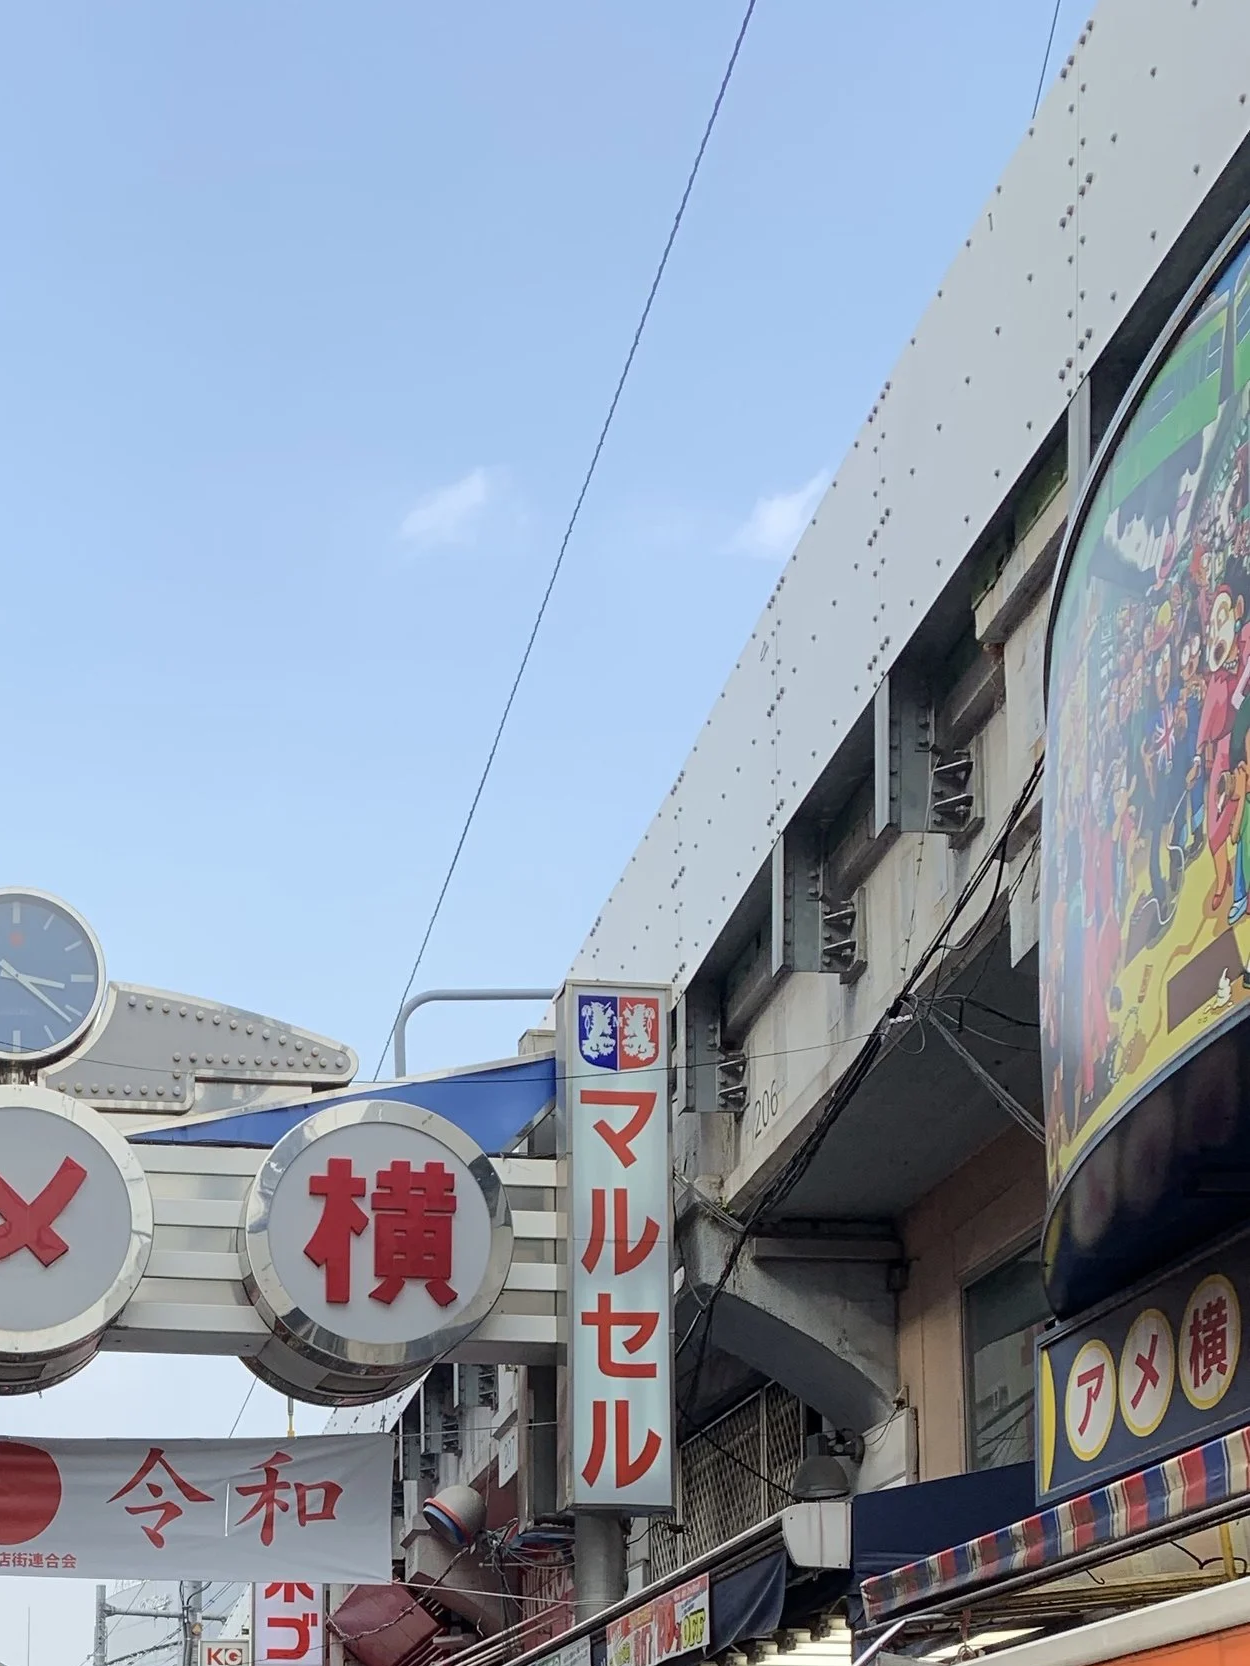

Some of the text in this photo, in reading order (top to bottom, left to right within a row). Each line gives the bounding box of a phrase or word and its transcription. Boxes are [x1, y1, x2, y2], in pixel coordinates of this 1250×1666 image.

[579, 1090, 663, 1490] マルセル
[1076, 1296, 1230, 1437] アメ横
[107, 1446, 344, 1549] 令和
[682, 1607, 706, 1649] OFF
